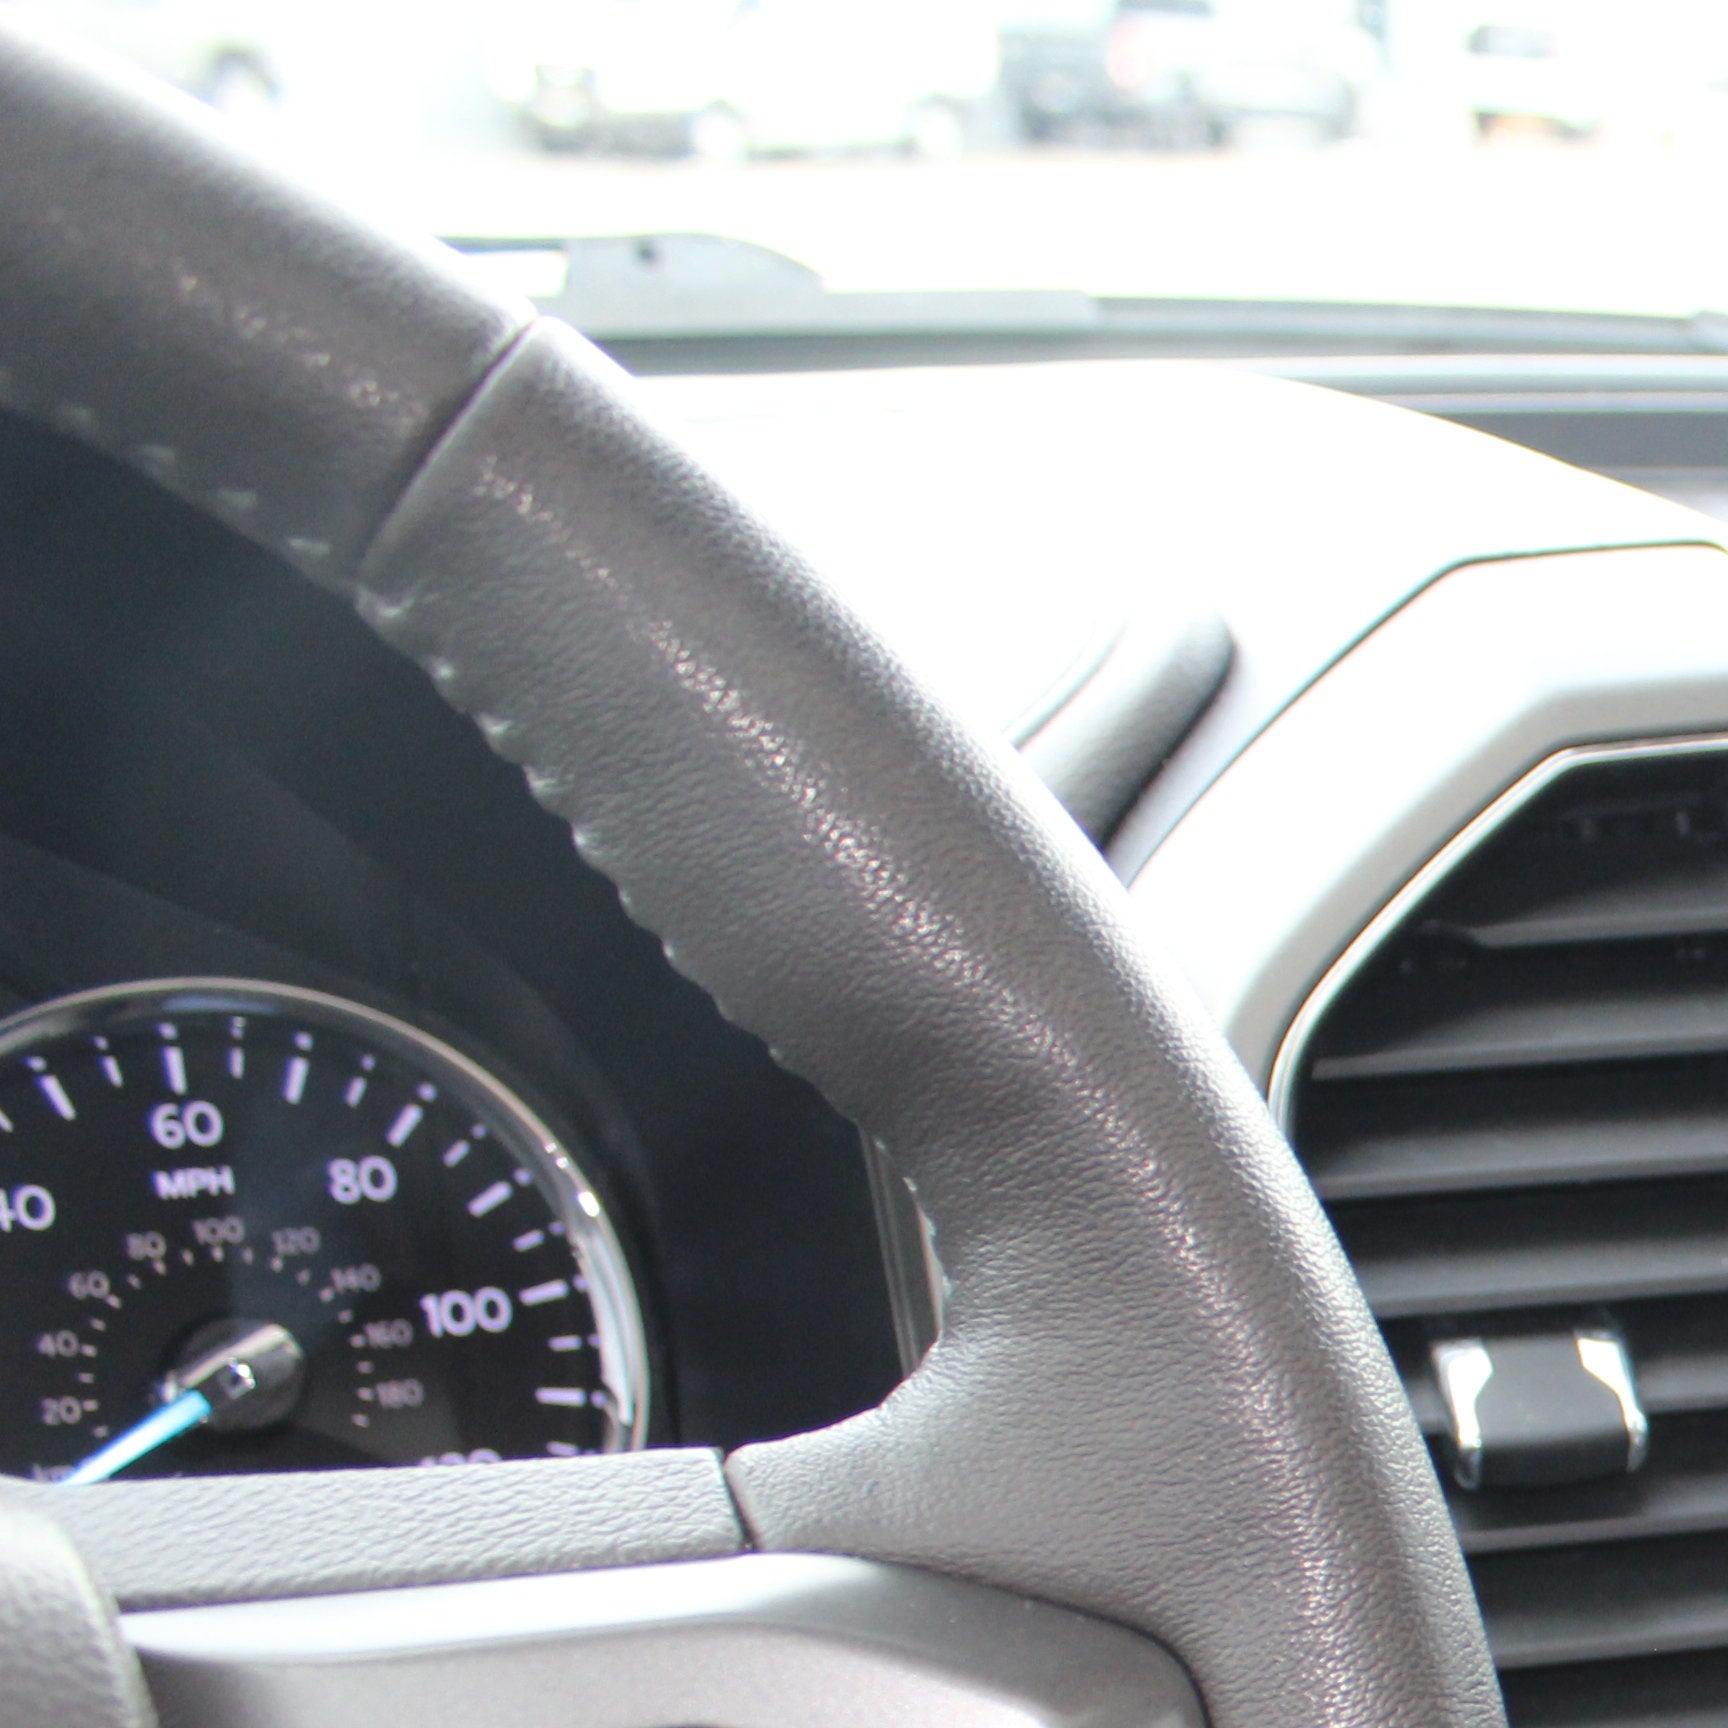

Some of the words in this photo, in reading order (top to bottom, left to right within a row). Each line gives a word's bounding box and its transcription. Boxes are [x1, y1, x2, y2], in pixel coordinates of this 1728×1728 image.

[150, 1101, 223, 1147] 60
[155, 1167, 235, 1198] MPH
[329, 1156, 396, 1204] 80
[193, 1216, 245, 1244] 100
[68, 1270, 110, 1299] 60
[420, 1288, 513, 1338] 100
